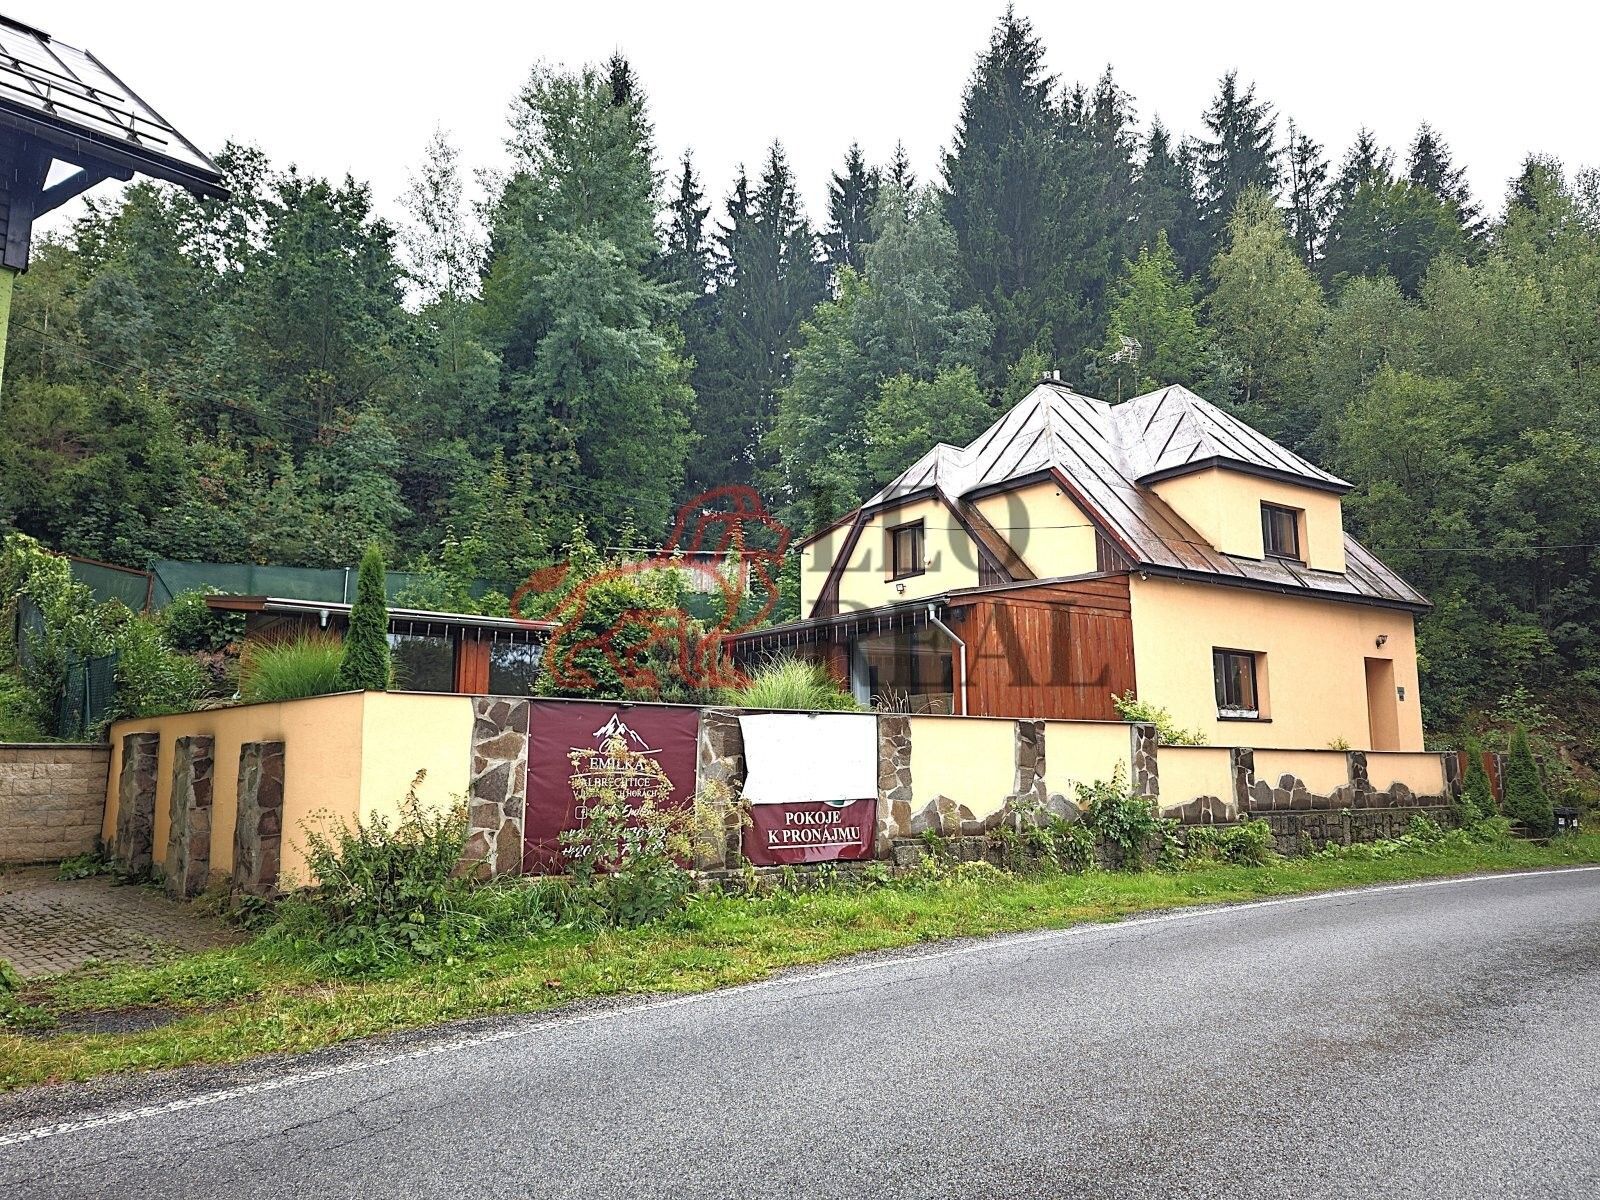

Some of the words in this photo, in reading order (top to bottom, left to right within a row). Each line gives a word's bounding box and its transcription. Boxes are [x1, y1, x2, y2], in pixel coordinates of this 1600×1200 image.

[589, 757, 645, 771] EMILKA
[785, 810, 841, 825] POKOJE
[768, 829, 779, 843] K
[782, 825, 860, 842] PRONÁJMU
